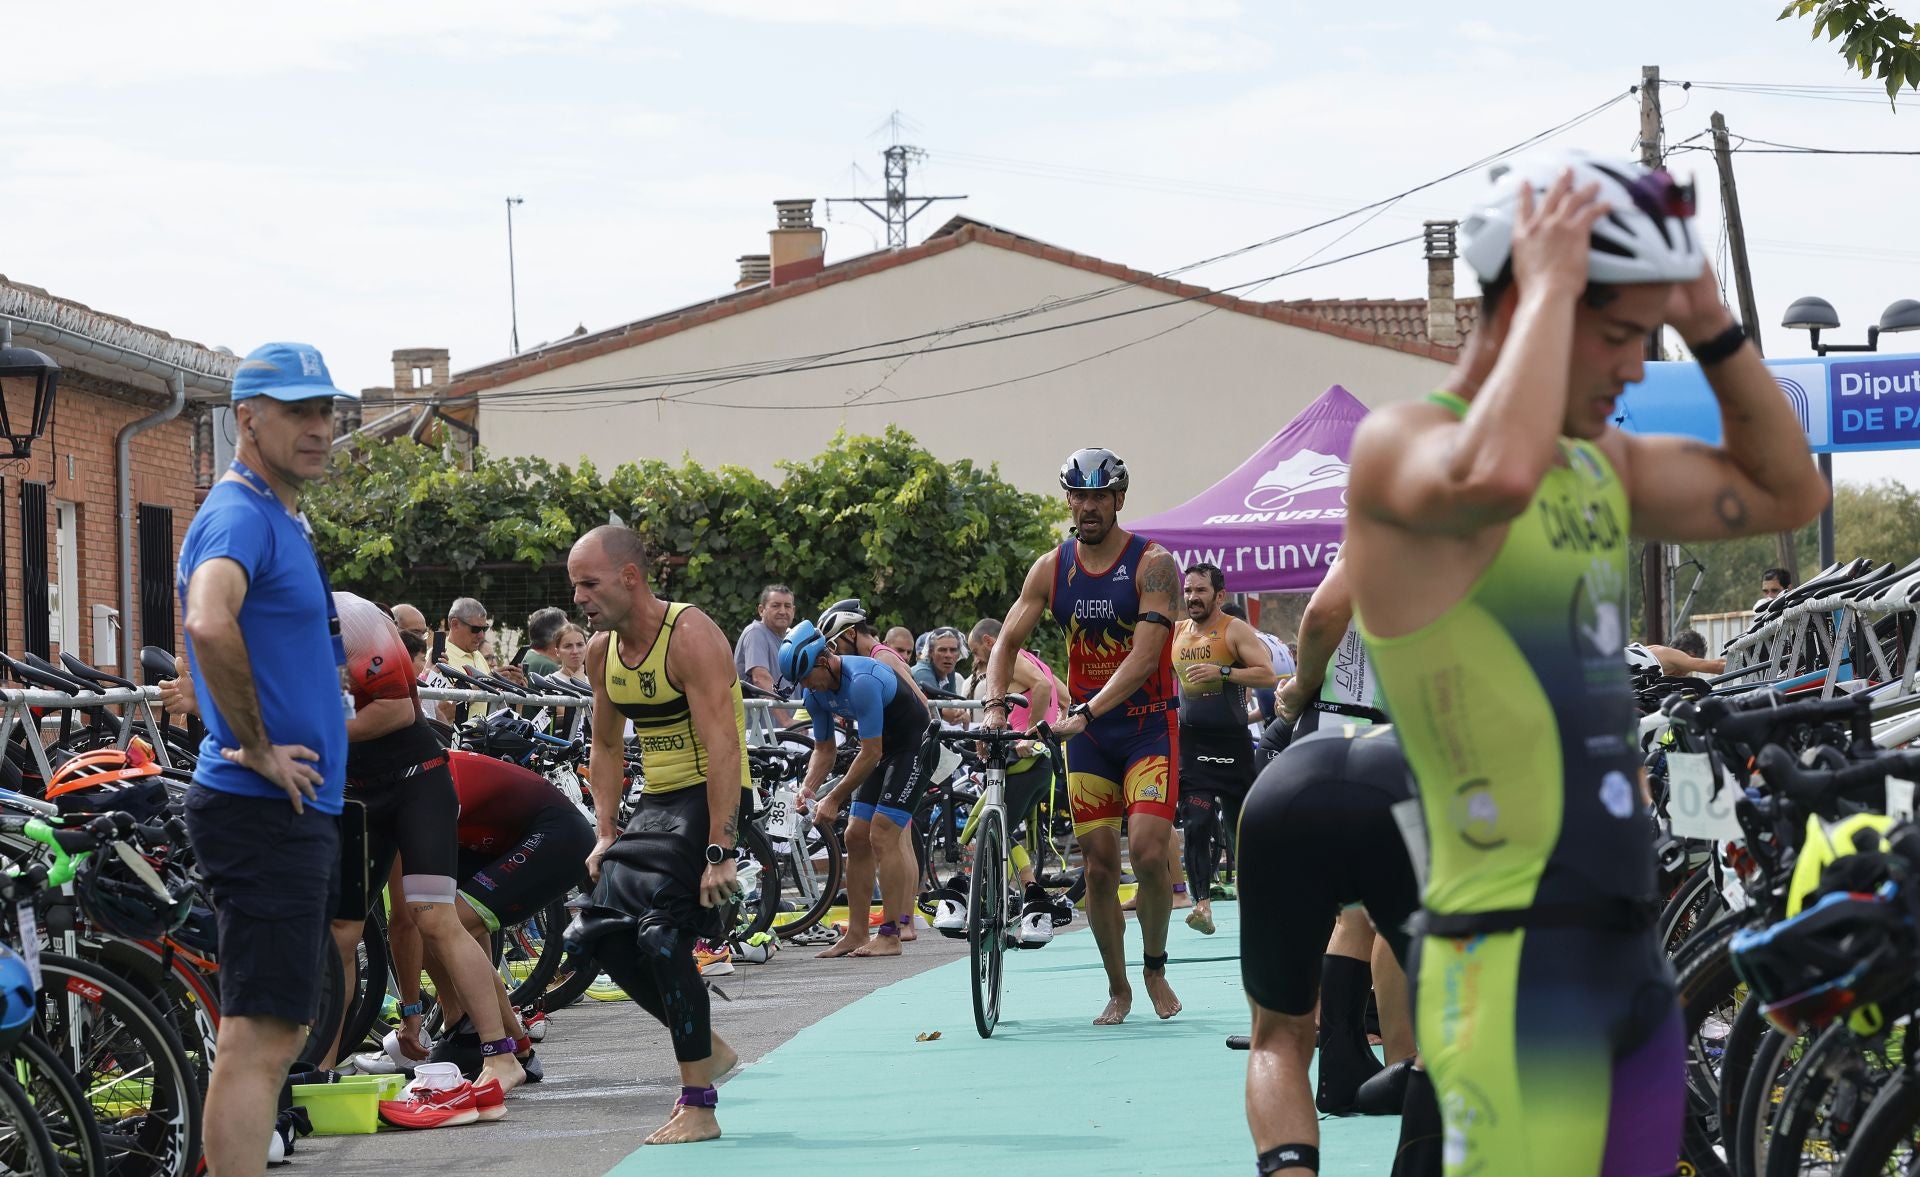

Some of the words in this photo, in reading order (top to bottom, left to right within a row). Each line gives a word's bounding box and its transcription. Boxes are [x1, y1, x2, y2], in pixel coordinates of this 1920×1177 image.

[1840, 370, 1920, 400] Diput
[1842, 407, 1885, 432] DE
[1203, 508, 1348, 525] RUNVAS
[1074, 598, 1116, 619] GUERRA
[1180, 645, 1211, 660] SANTOS
[1127, 701, 1168, 716] ZONE3
[1197, 755, 1234, 764] orca
[771, 801, 787, 826] 385
